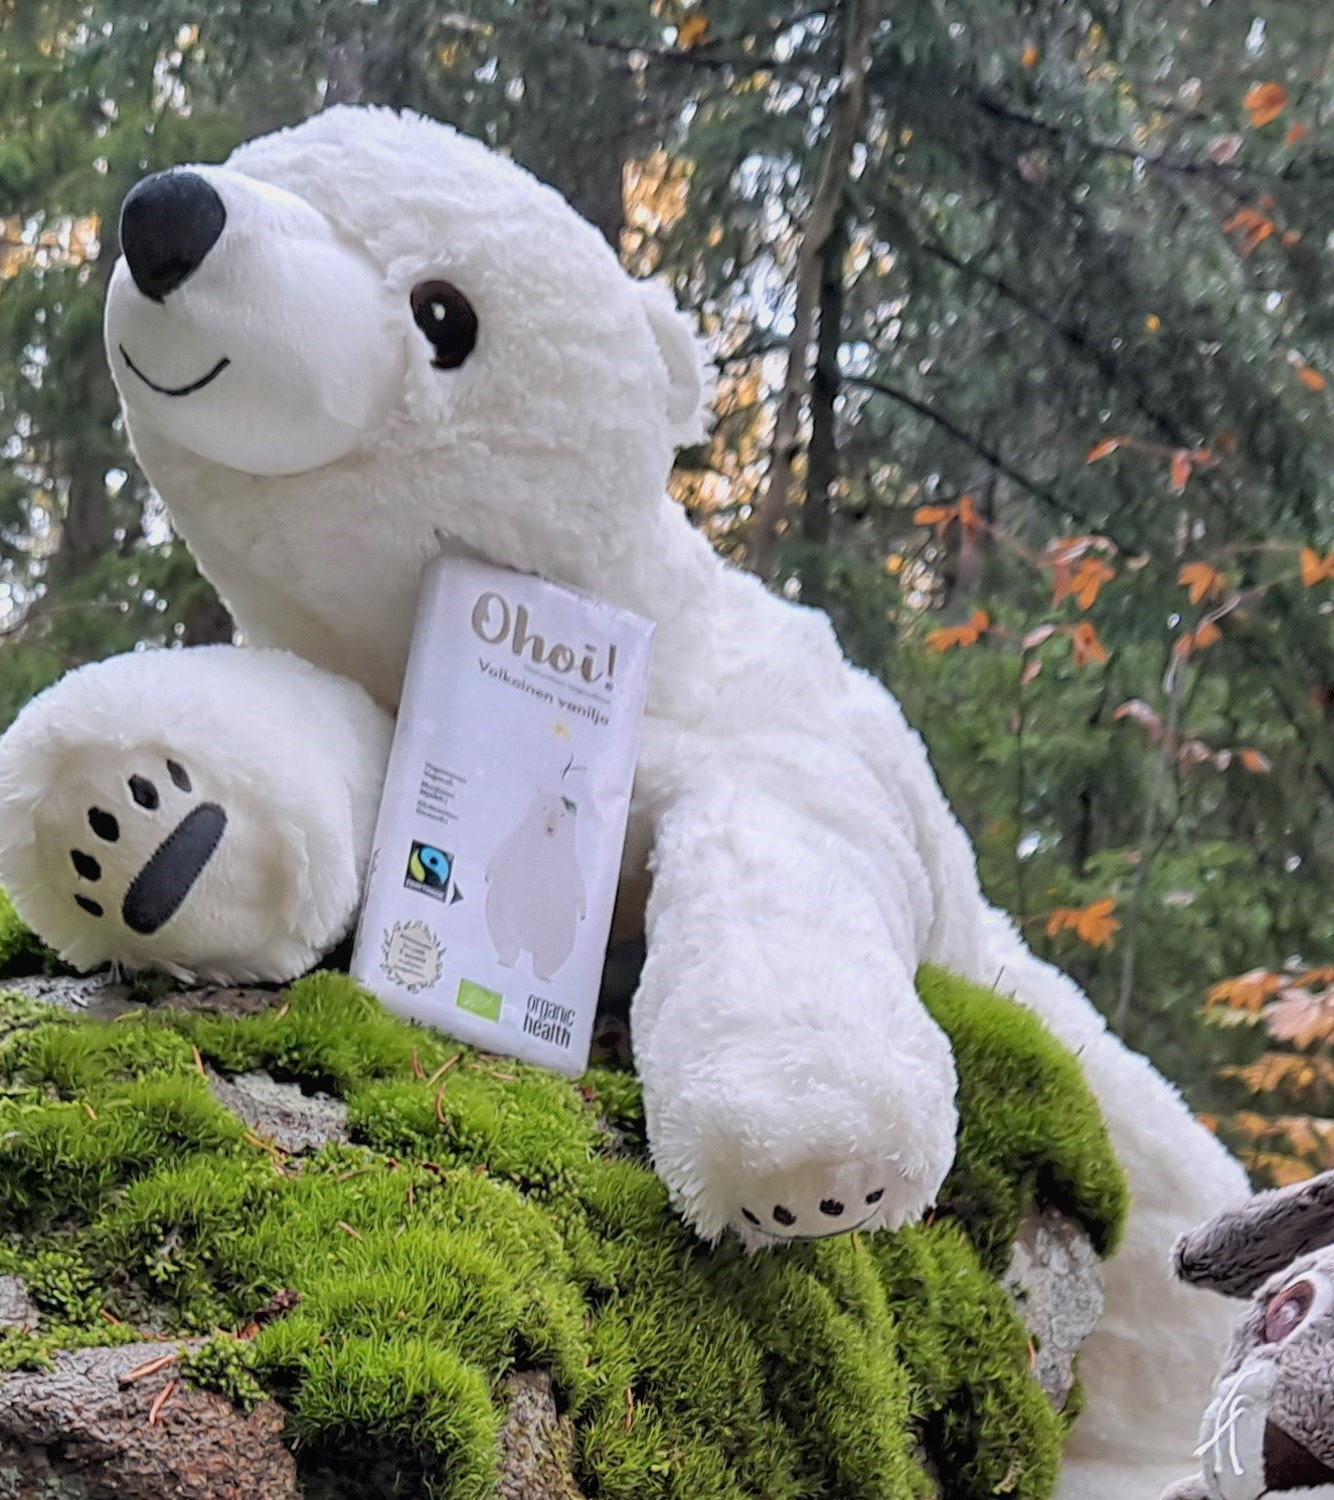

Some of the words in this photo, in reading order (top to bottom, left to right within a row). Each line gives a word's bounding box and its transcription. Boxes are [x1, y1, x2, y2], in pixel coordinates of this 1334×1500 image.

[471, 591, 617, 691] Ohoi!
[527, 994, 576, 1027] organic
[523, 1013, 571, 1049] health
